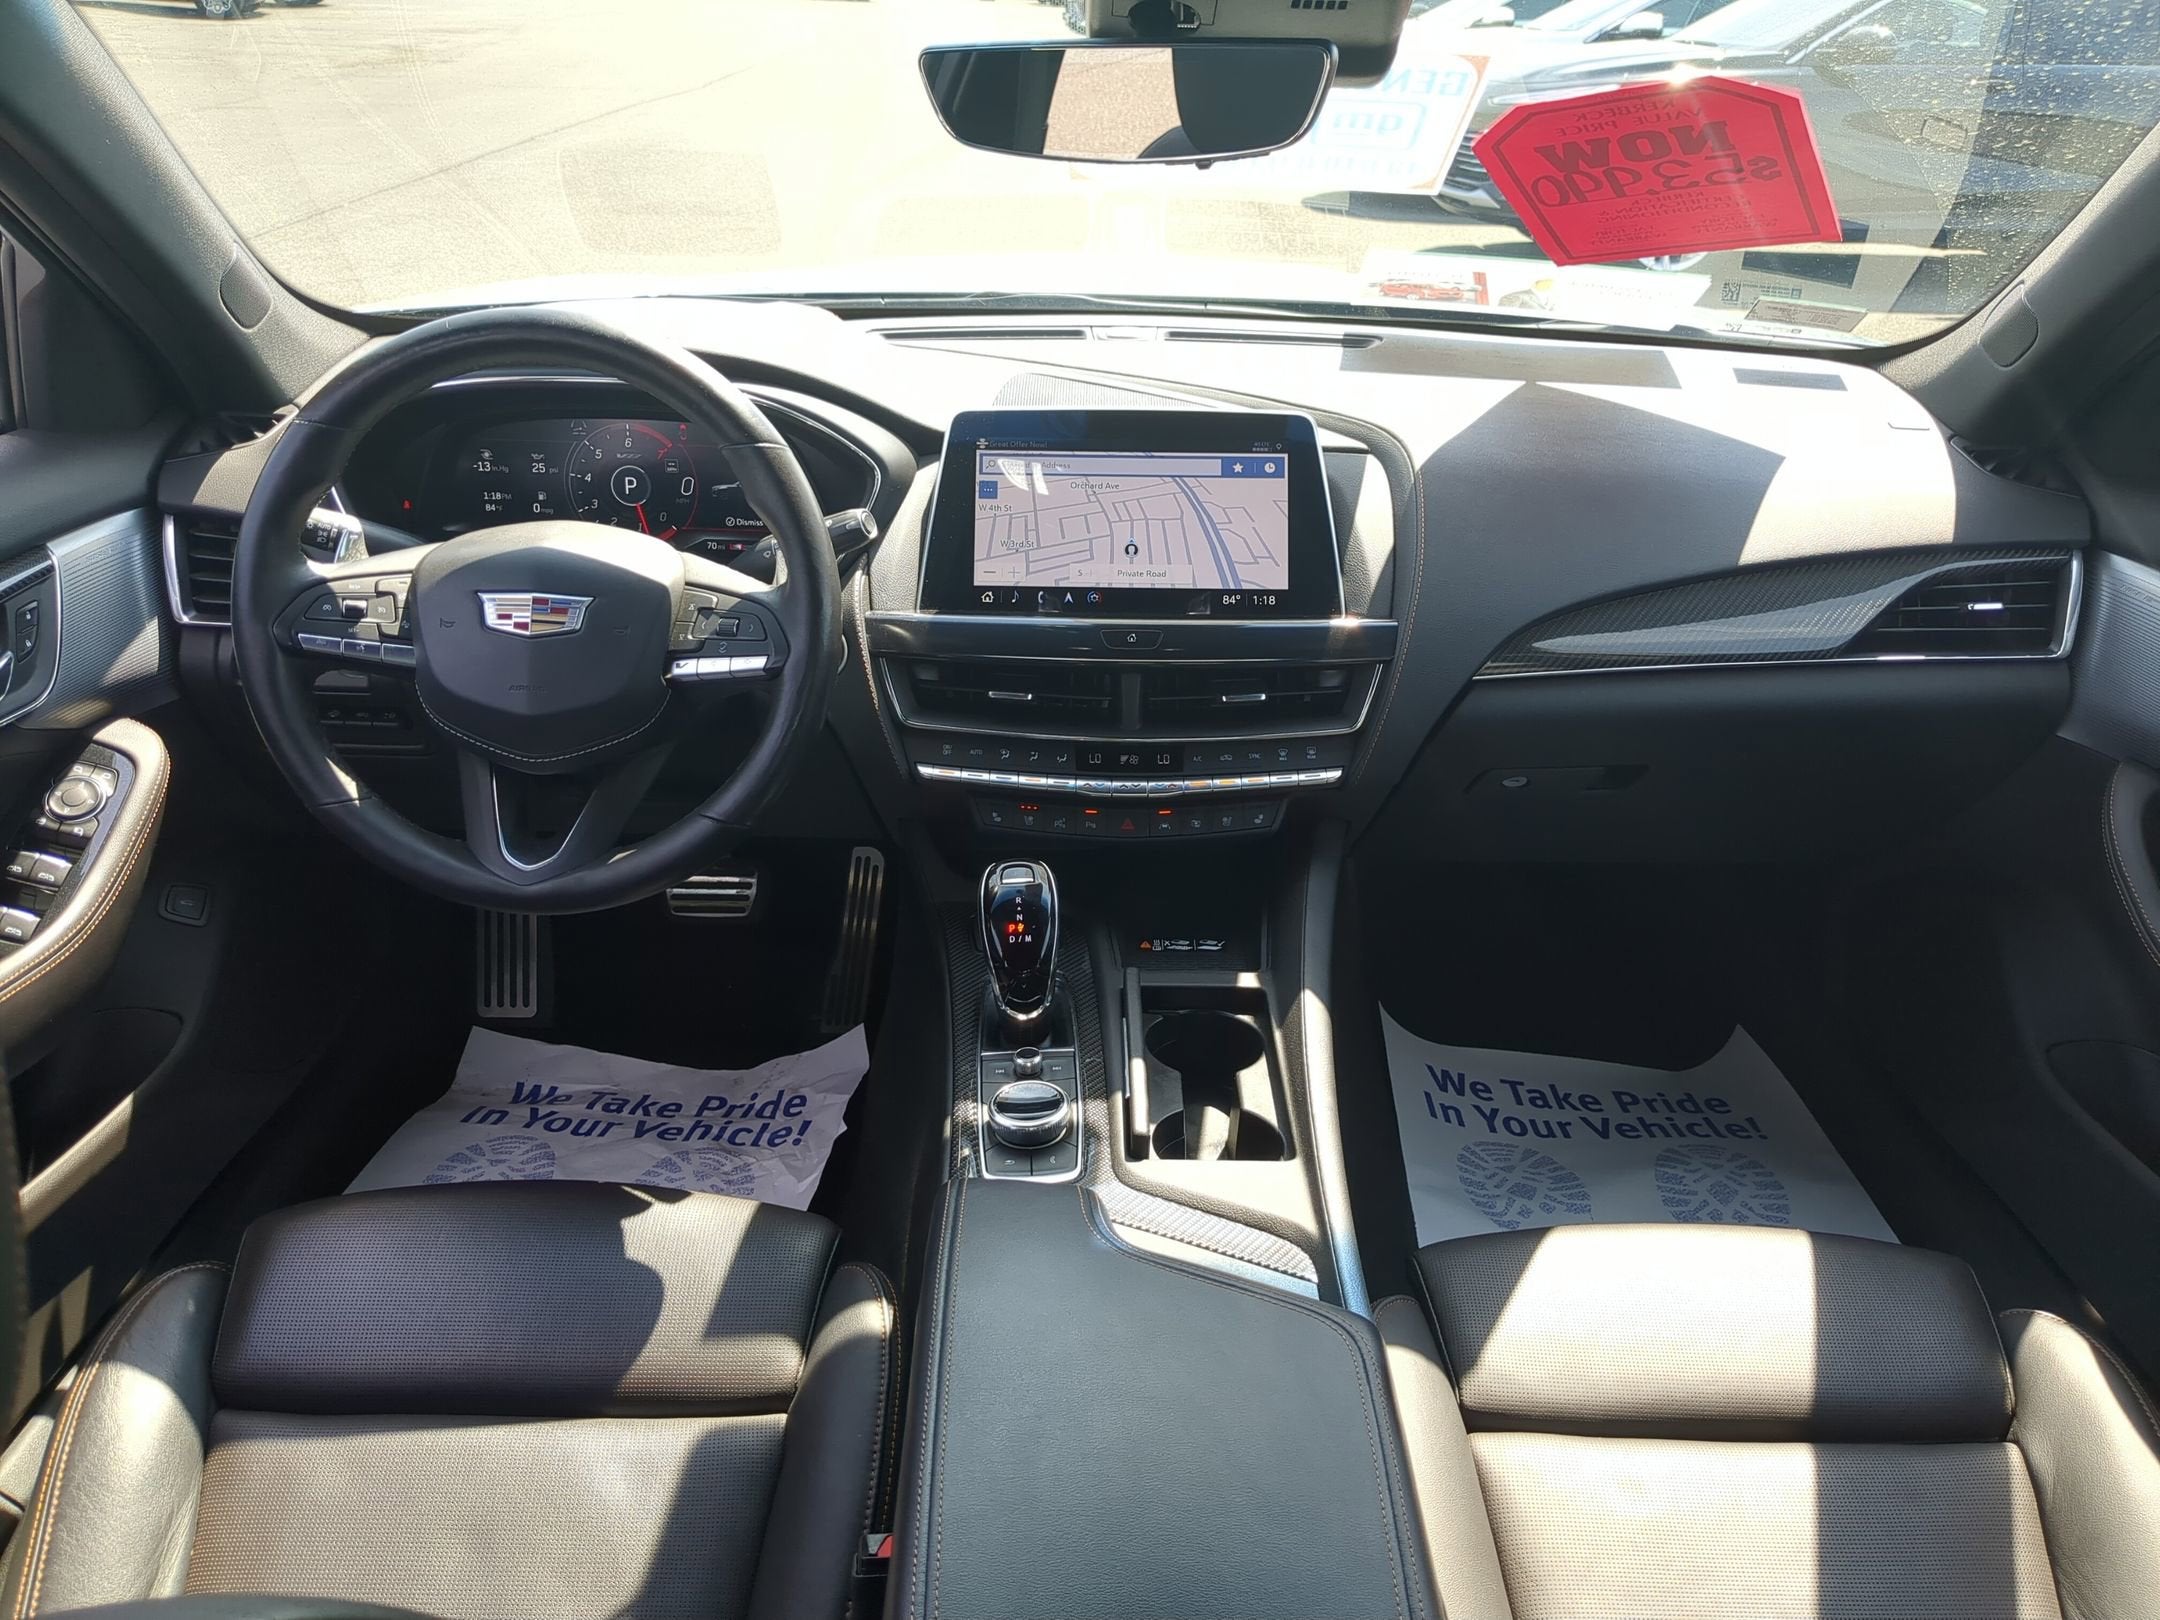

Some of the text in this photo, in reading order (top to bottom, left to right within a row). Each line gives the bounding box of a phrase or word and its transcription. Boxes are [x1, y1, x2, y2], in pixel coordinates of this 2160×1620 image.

[624, 437, 633, 448] 6
[594, 448, 602, 459] 5
[531, 463, 546, 473] 25
[584, 473, 592, 482] 4
[624, 477, 637, 494] P
[681, 476, 695, 495] 0
[1070, 481, 1120, 491] Orchard Ave
[591, 499, 598, 509] 3
[1003, 504, 1013, 512] St
[736, 518, 764, 527] Dismiss
[1025, 540, 1035, 548] St
[1117, 569, 1167, 578] Private Road
[1252, 595, 1276, 606] 1:18
[1088, 753, 1102, 764] LO
[1157, 753, 1170, 765] LO
[1015, 896, 1022, 904] R
[1016, 913, 1023, 921] N
[1424, 1062, 1733, 1115] We Take Pride
[511, 1081, 808, 1120] We Take Pride
[1423, 1090, 1769, 1141] In Your Vehicle!
[459, 1105, 814, 1148] In Your Vehicle!
